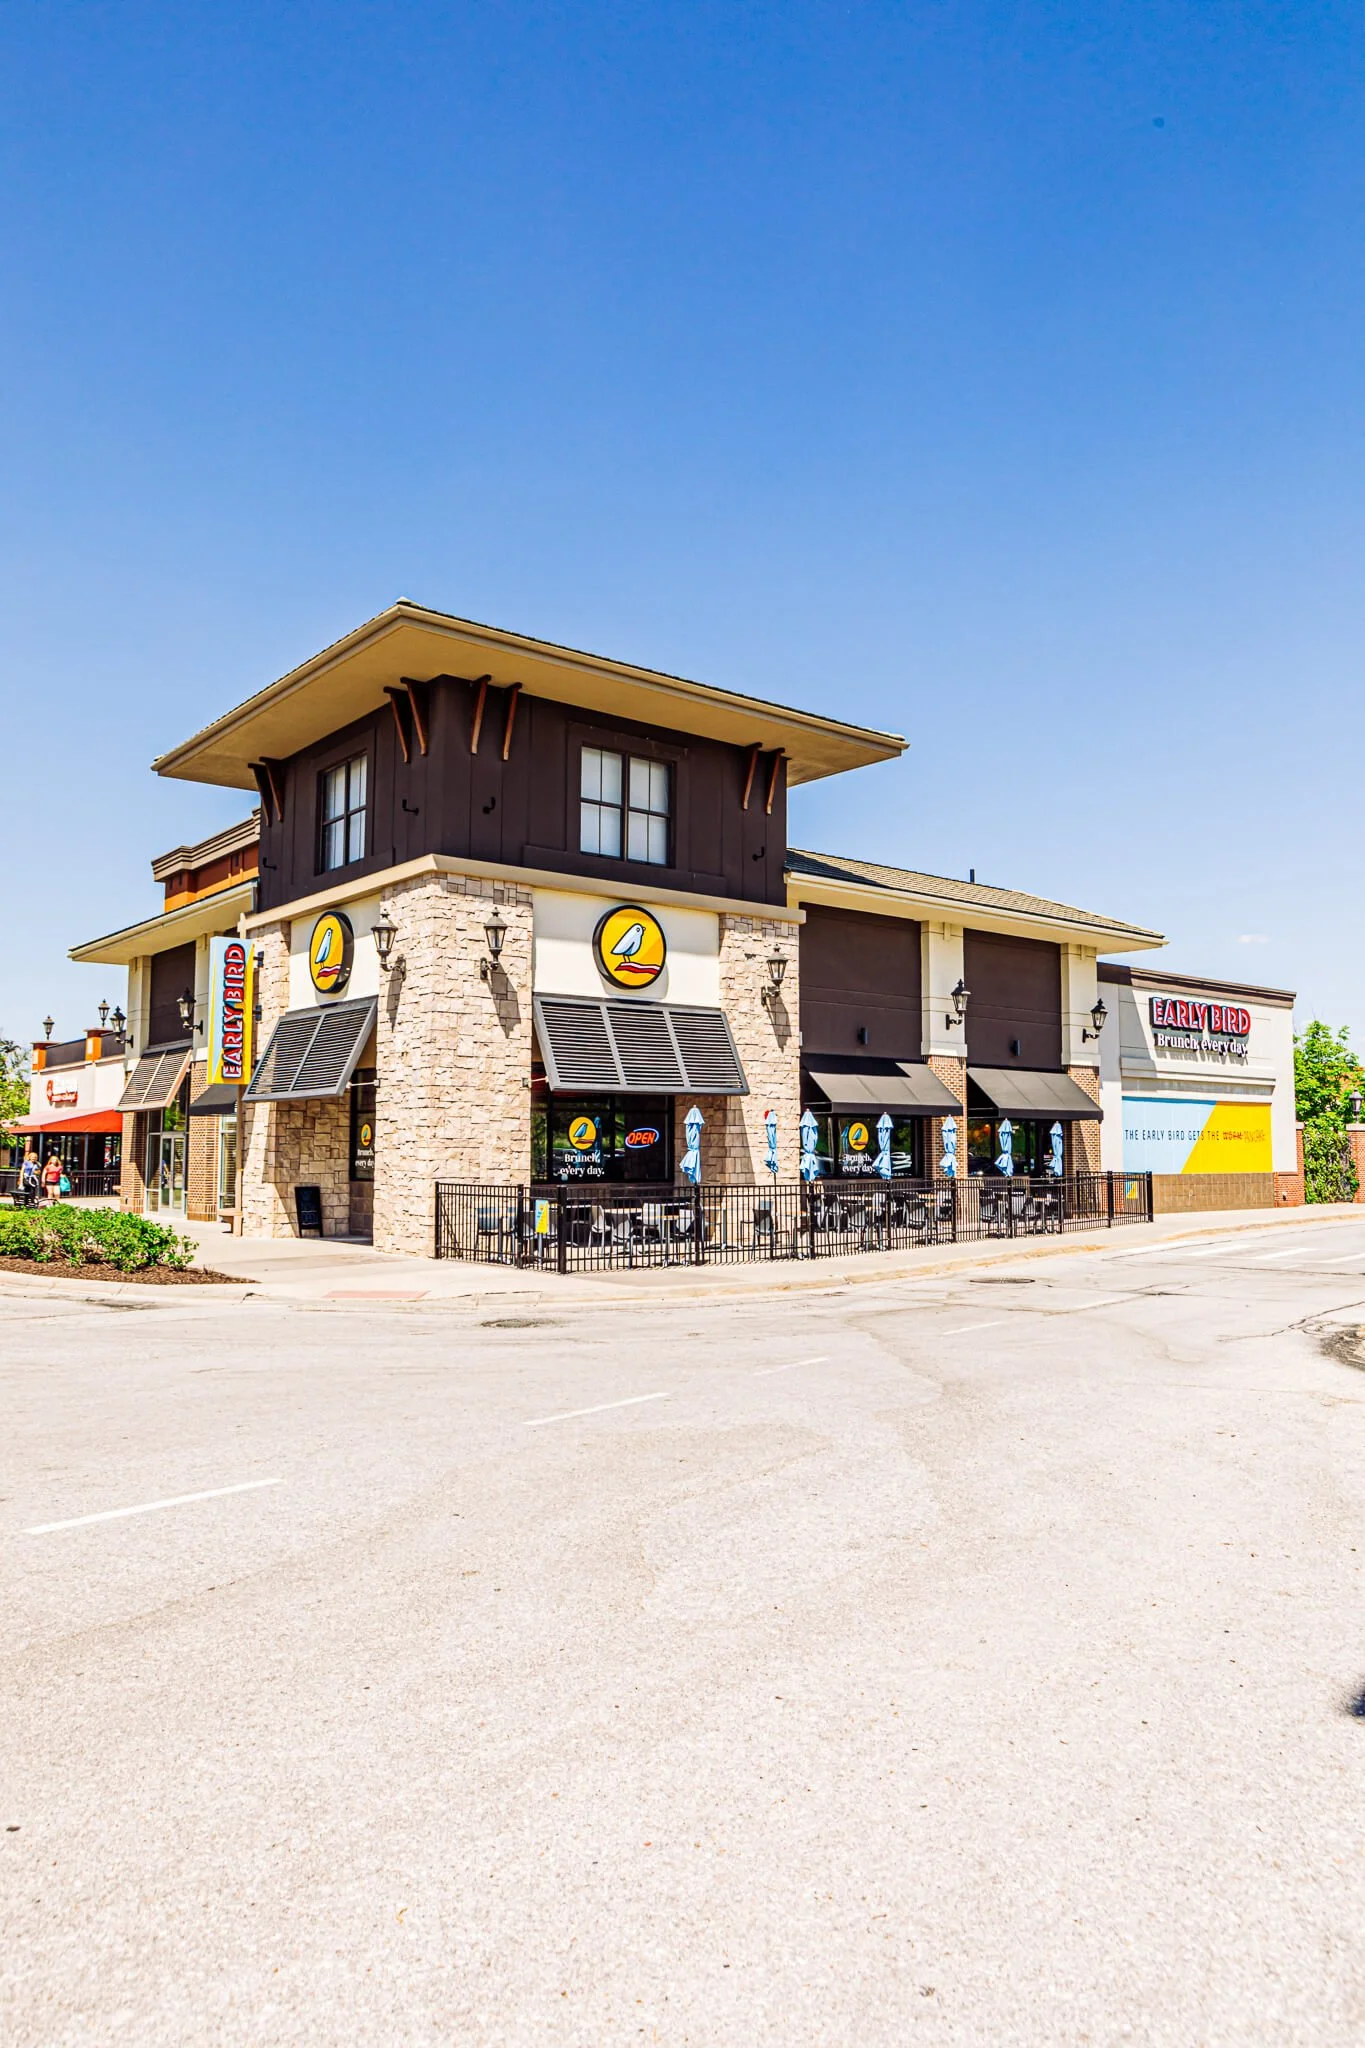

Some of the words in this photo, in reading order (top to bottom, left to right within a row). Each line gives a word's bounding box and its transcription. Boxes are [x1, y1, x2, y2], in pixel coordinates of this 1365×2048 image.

[223, 943, 245, 1003] BIRD
[1150, 997, 1207, 1030] EARLY
[1209, 1004, 1251, 1035] BIRD
[222, 1004, 244, 1078] EARLY
[628, 1132, 655, 1144] OPEN
[1125, 1129, 1140, 1141] THE
[1142, 1130, 1165, 1141] EARLY
[1168, 1130, 1185, 1141] BIRD
[1188, 1130, 1205, 1141] GETS
[1207, 1130, 1220, 1141] THE
[560, 1165, 586, 1177] every
[587, 1165, 605, 1177] day.
[842, 1165, 860, 1174] every
